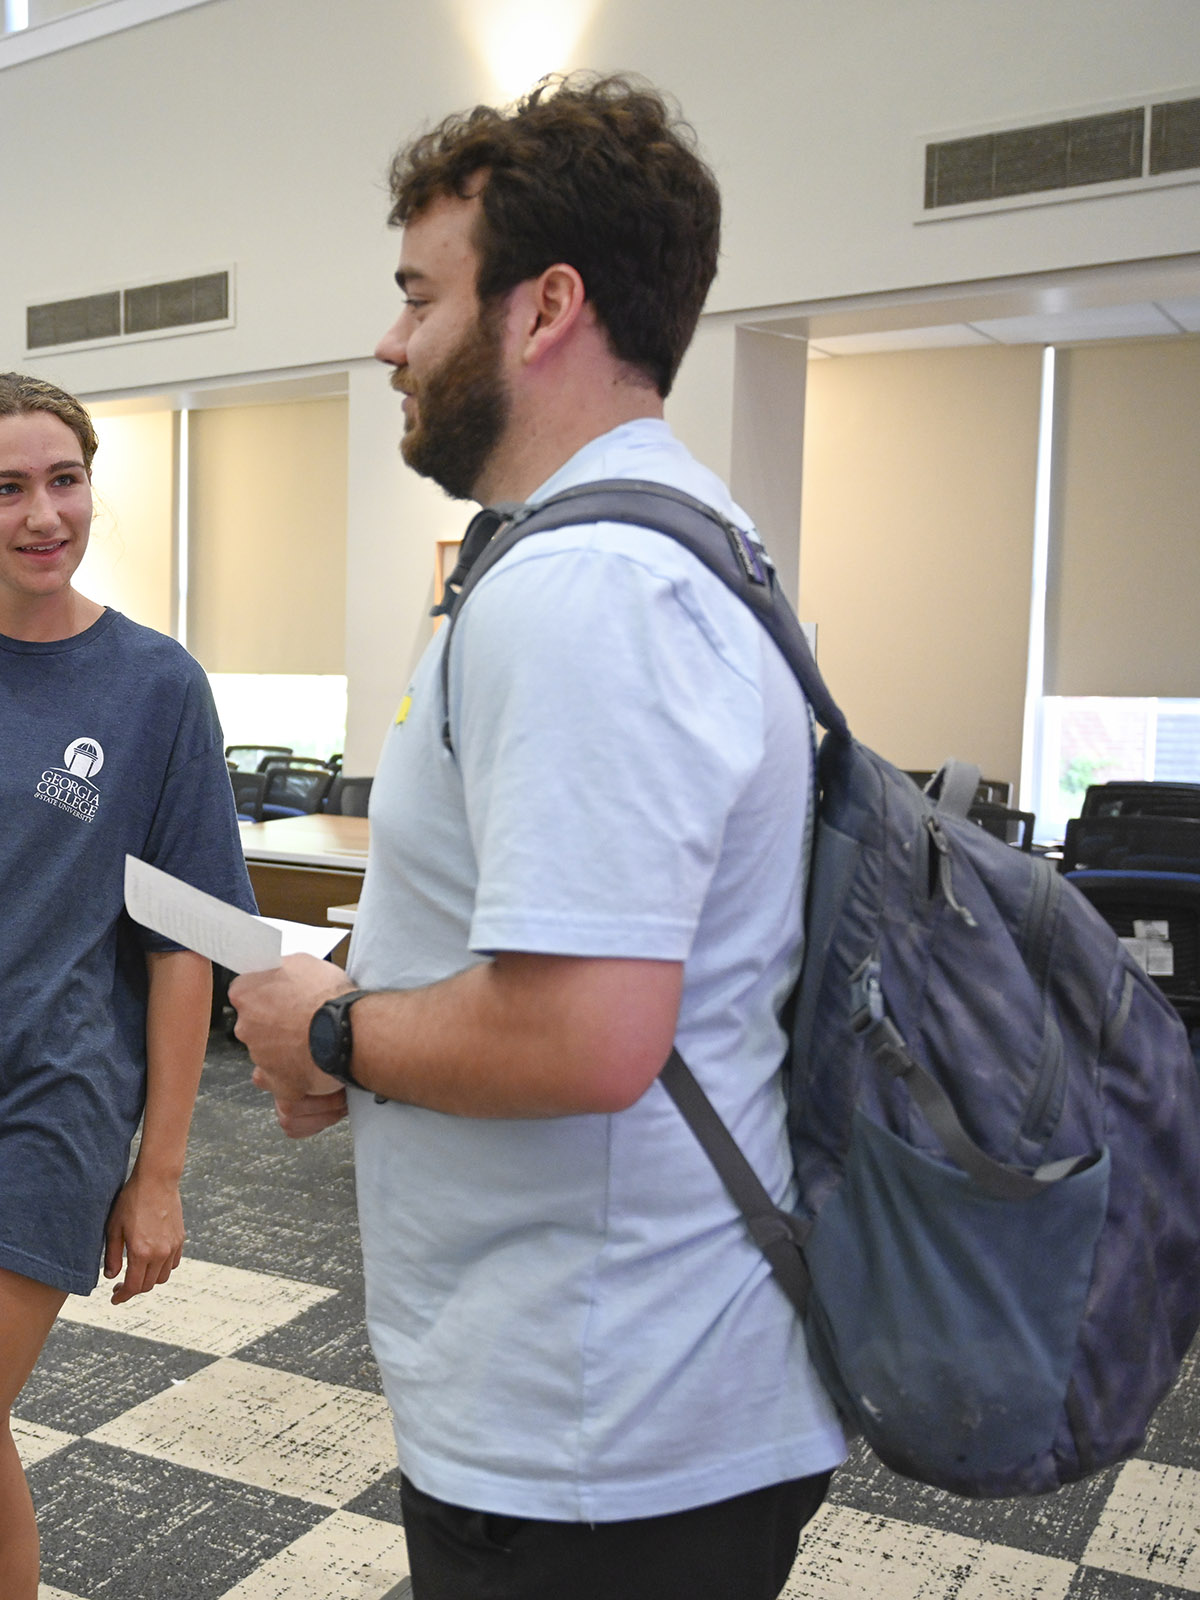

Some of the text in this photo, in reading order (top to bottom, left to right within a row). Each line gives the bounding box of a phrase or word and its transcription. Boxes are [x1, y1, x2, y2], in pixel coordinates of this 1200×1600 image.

[36, 781, 98, 817] COLLEGE
[41, 770, 99, 806] GEORGIA
[39, 793, 57, 806] STATE
[58, 802, 94, 823] UNIVERSITY
